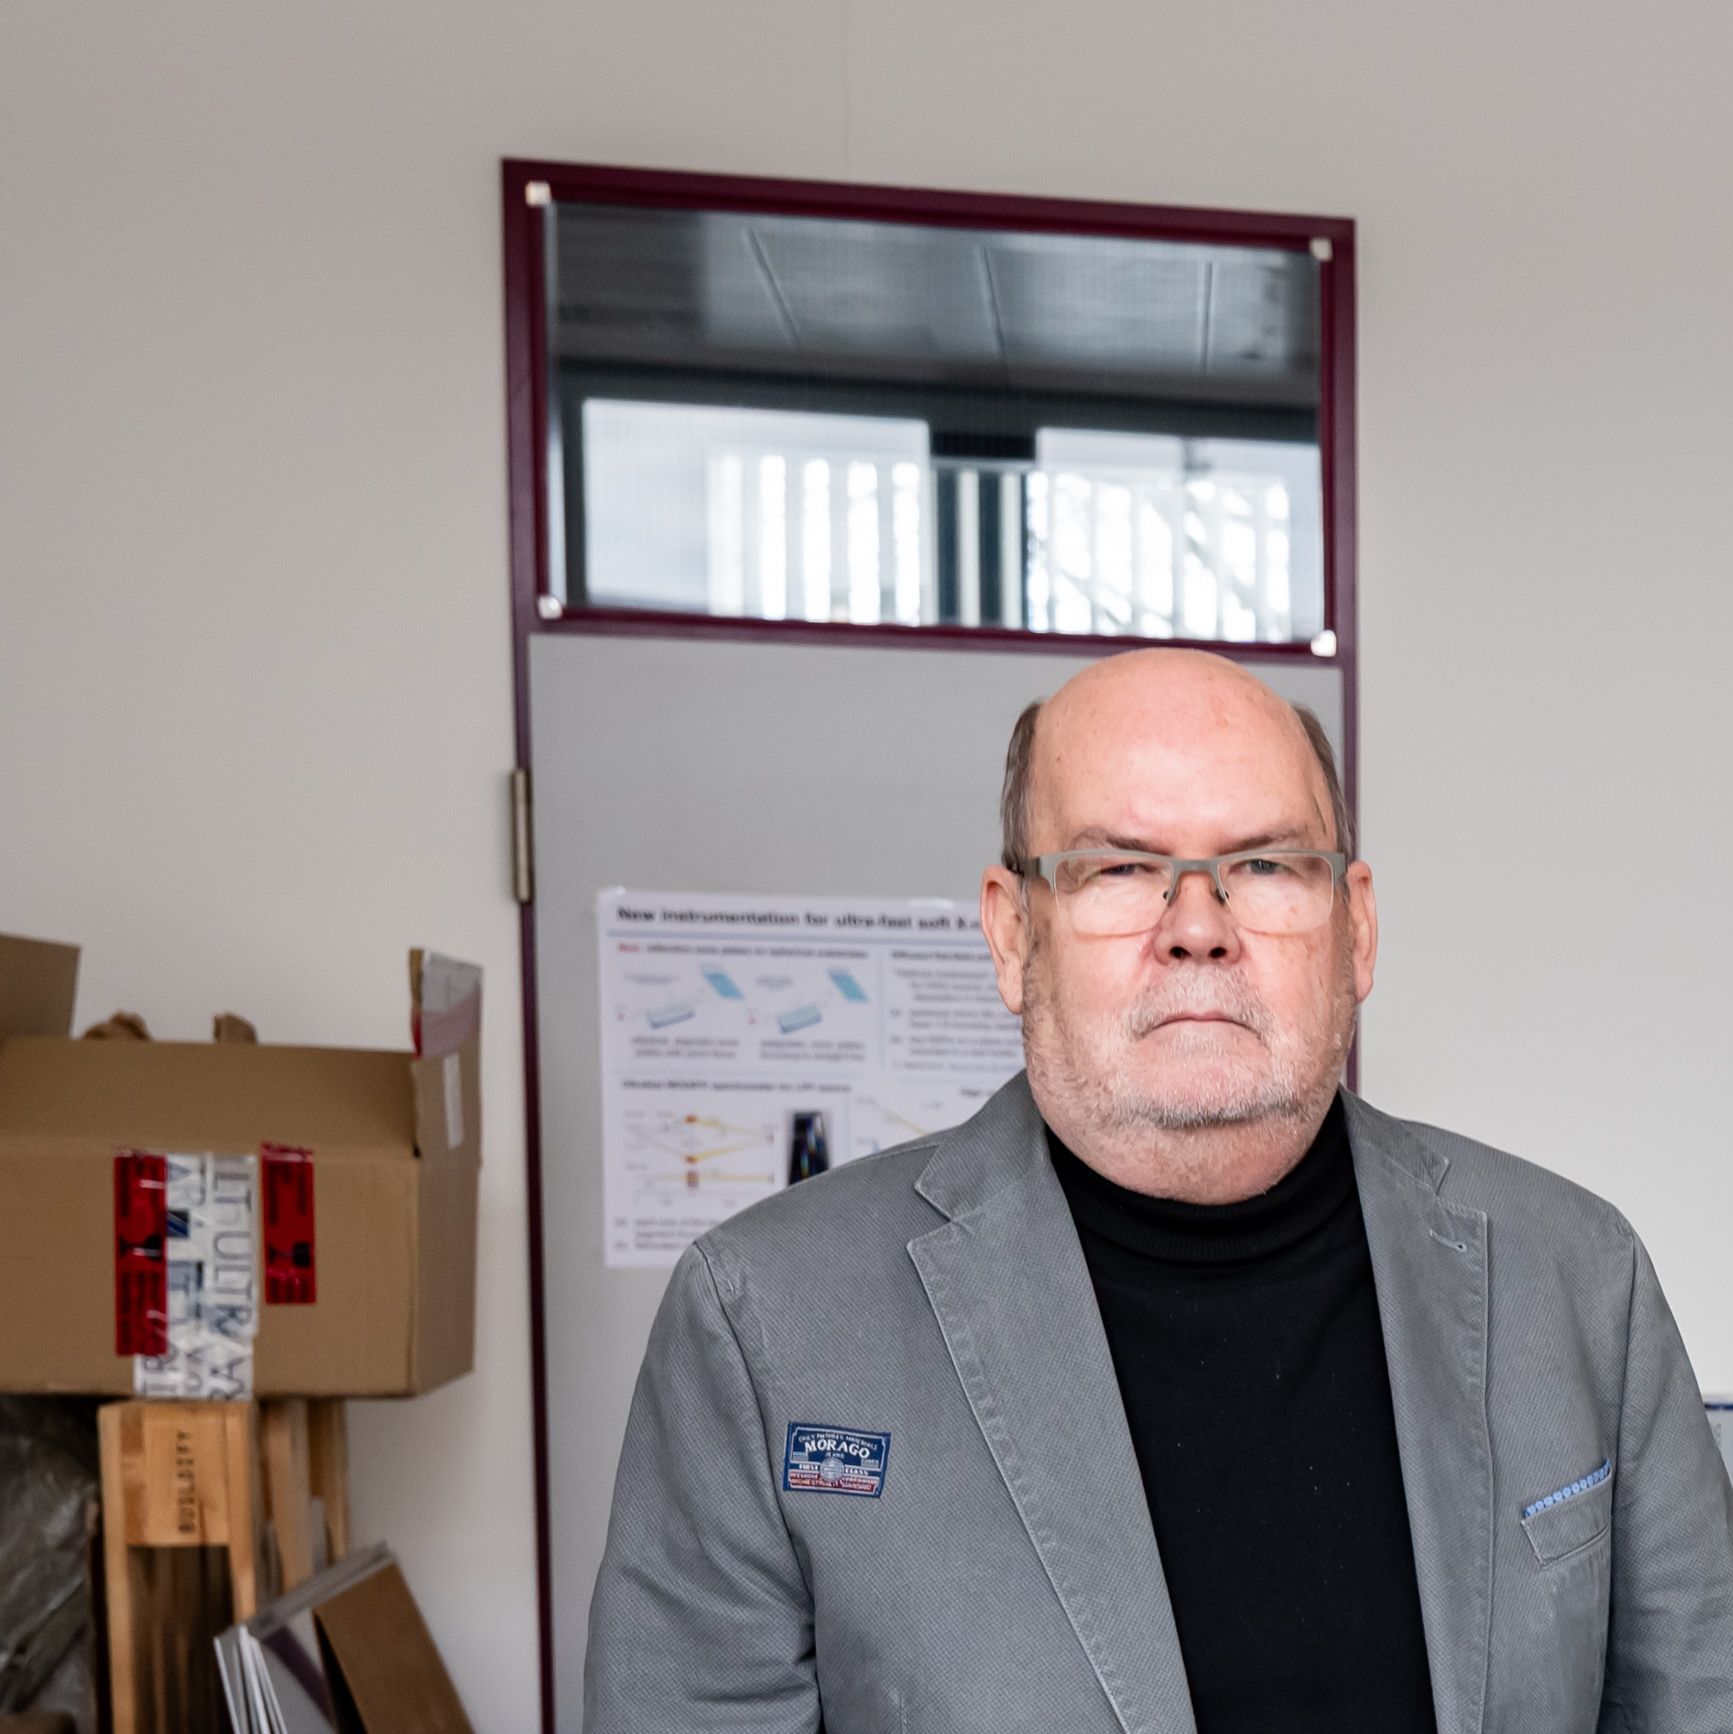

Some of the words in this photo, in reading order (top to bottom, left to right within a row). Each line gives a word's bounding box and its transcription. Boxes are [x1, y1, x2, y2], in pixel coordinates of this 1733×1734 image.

[617, 907, 655, 922] New
[661, 908, 800, 926] instrumentation
[805, 910, 828, 925] for
[804, 1438, 870, 1459] MORAGO
[845, 1466, 869, 1477] CLASS
